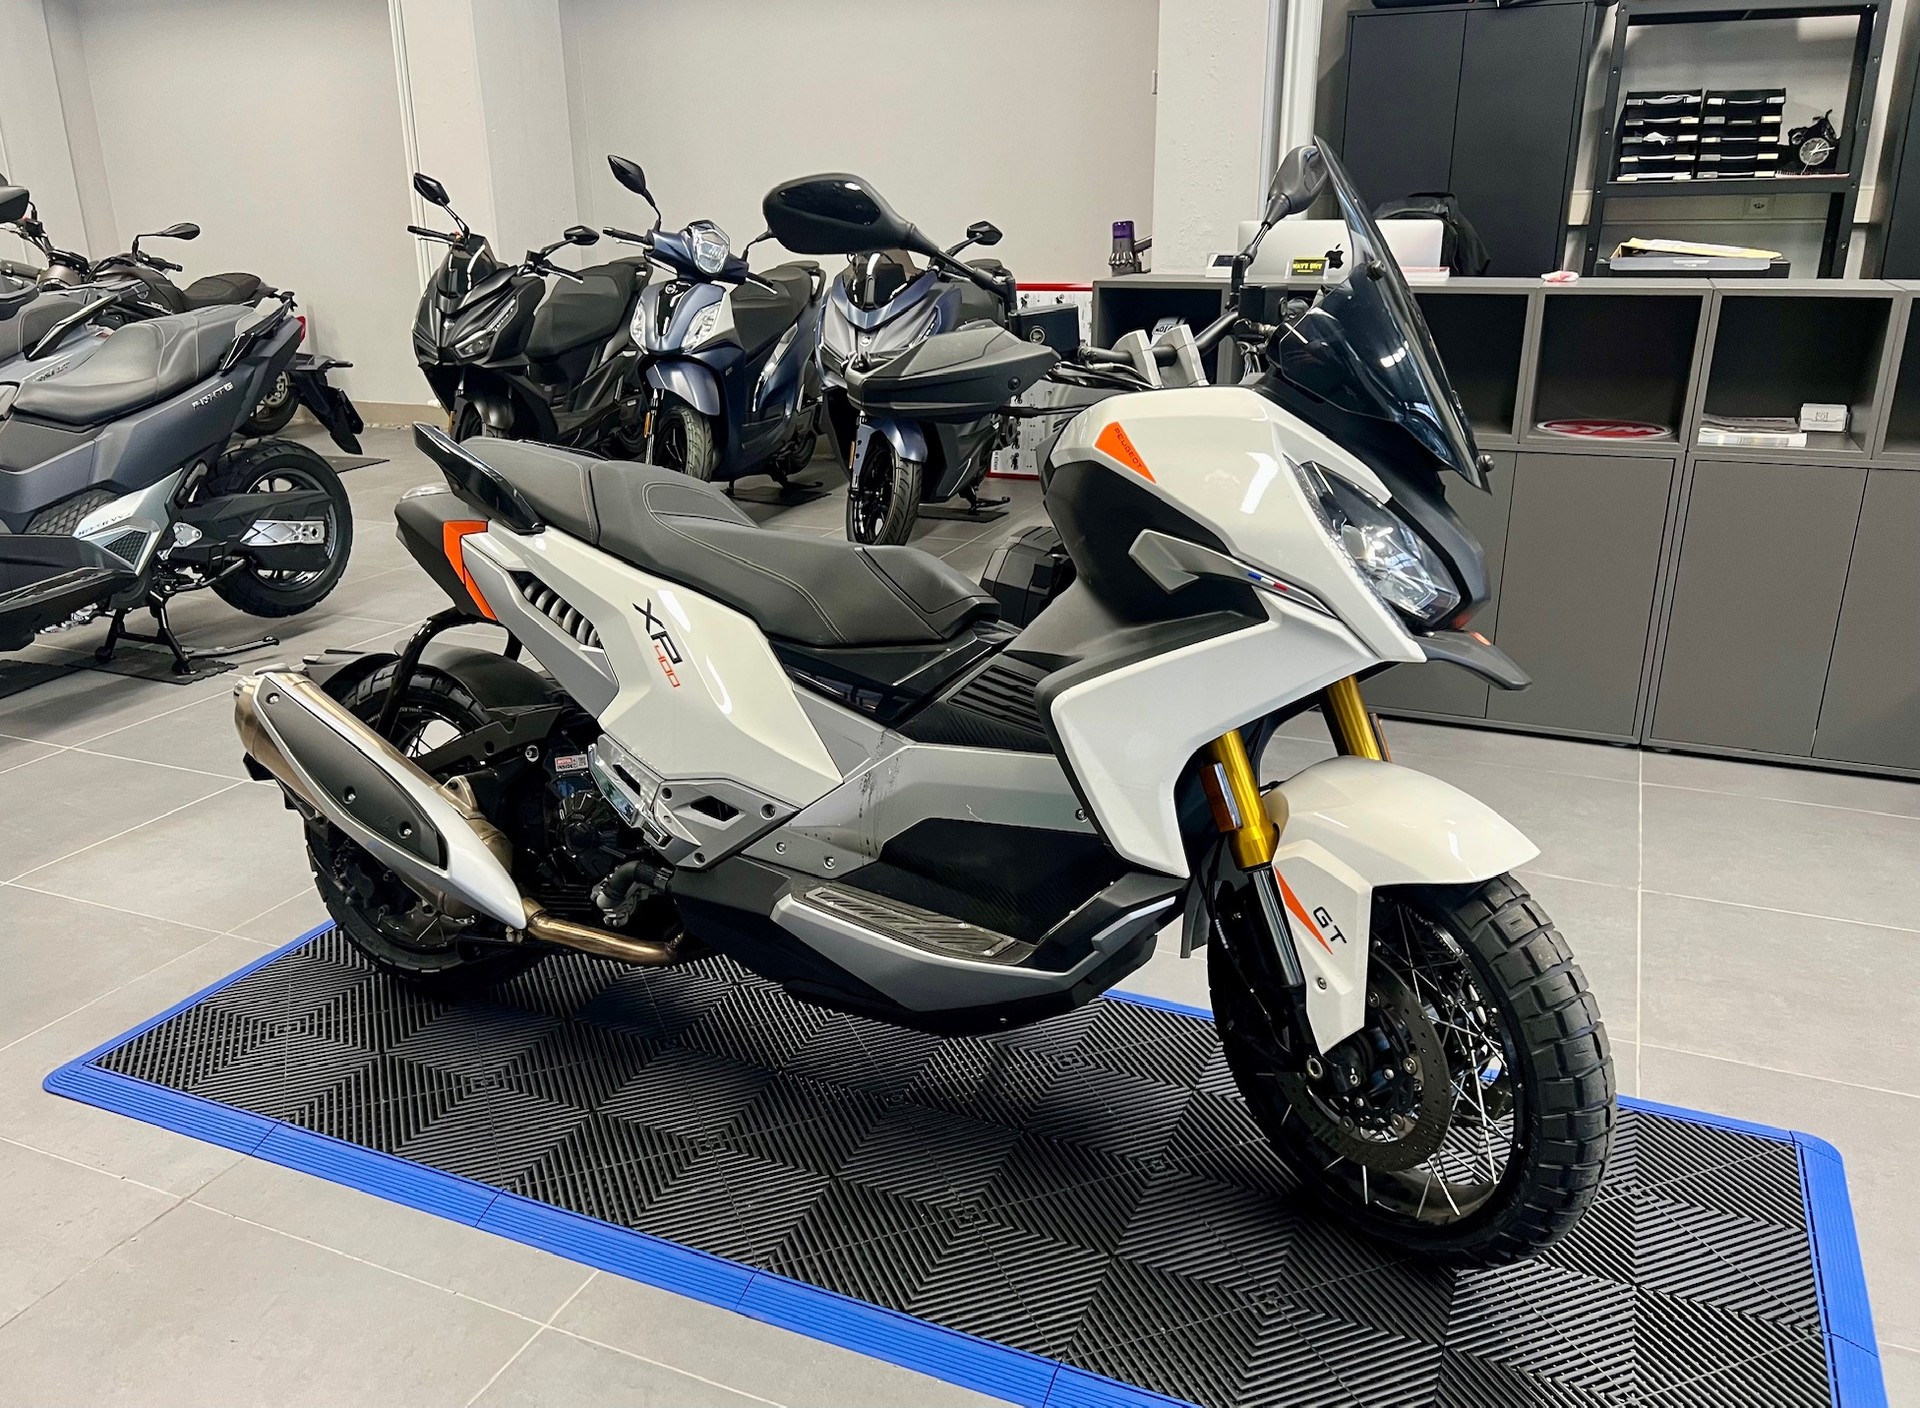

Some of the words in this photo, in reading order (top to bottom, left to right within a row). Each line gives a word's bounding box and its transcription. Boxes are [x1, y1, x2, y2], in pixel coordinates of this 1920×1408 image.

[1114, 427, 1143, 468] PEUGEOT
[632, 597, 683, 664] XP
[654, 644, 681, 687] 400
[1313, 906, 1347, 944] GT
